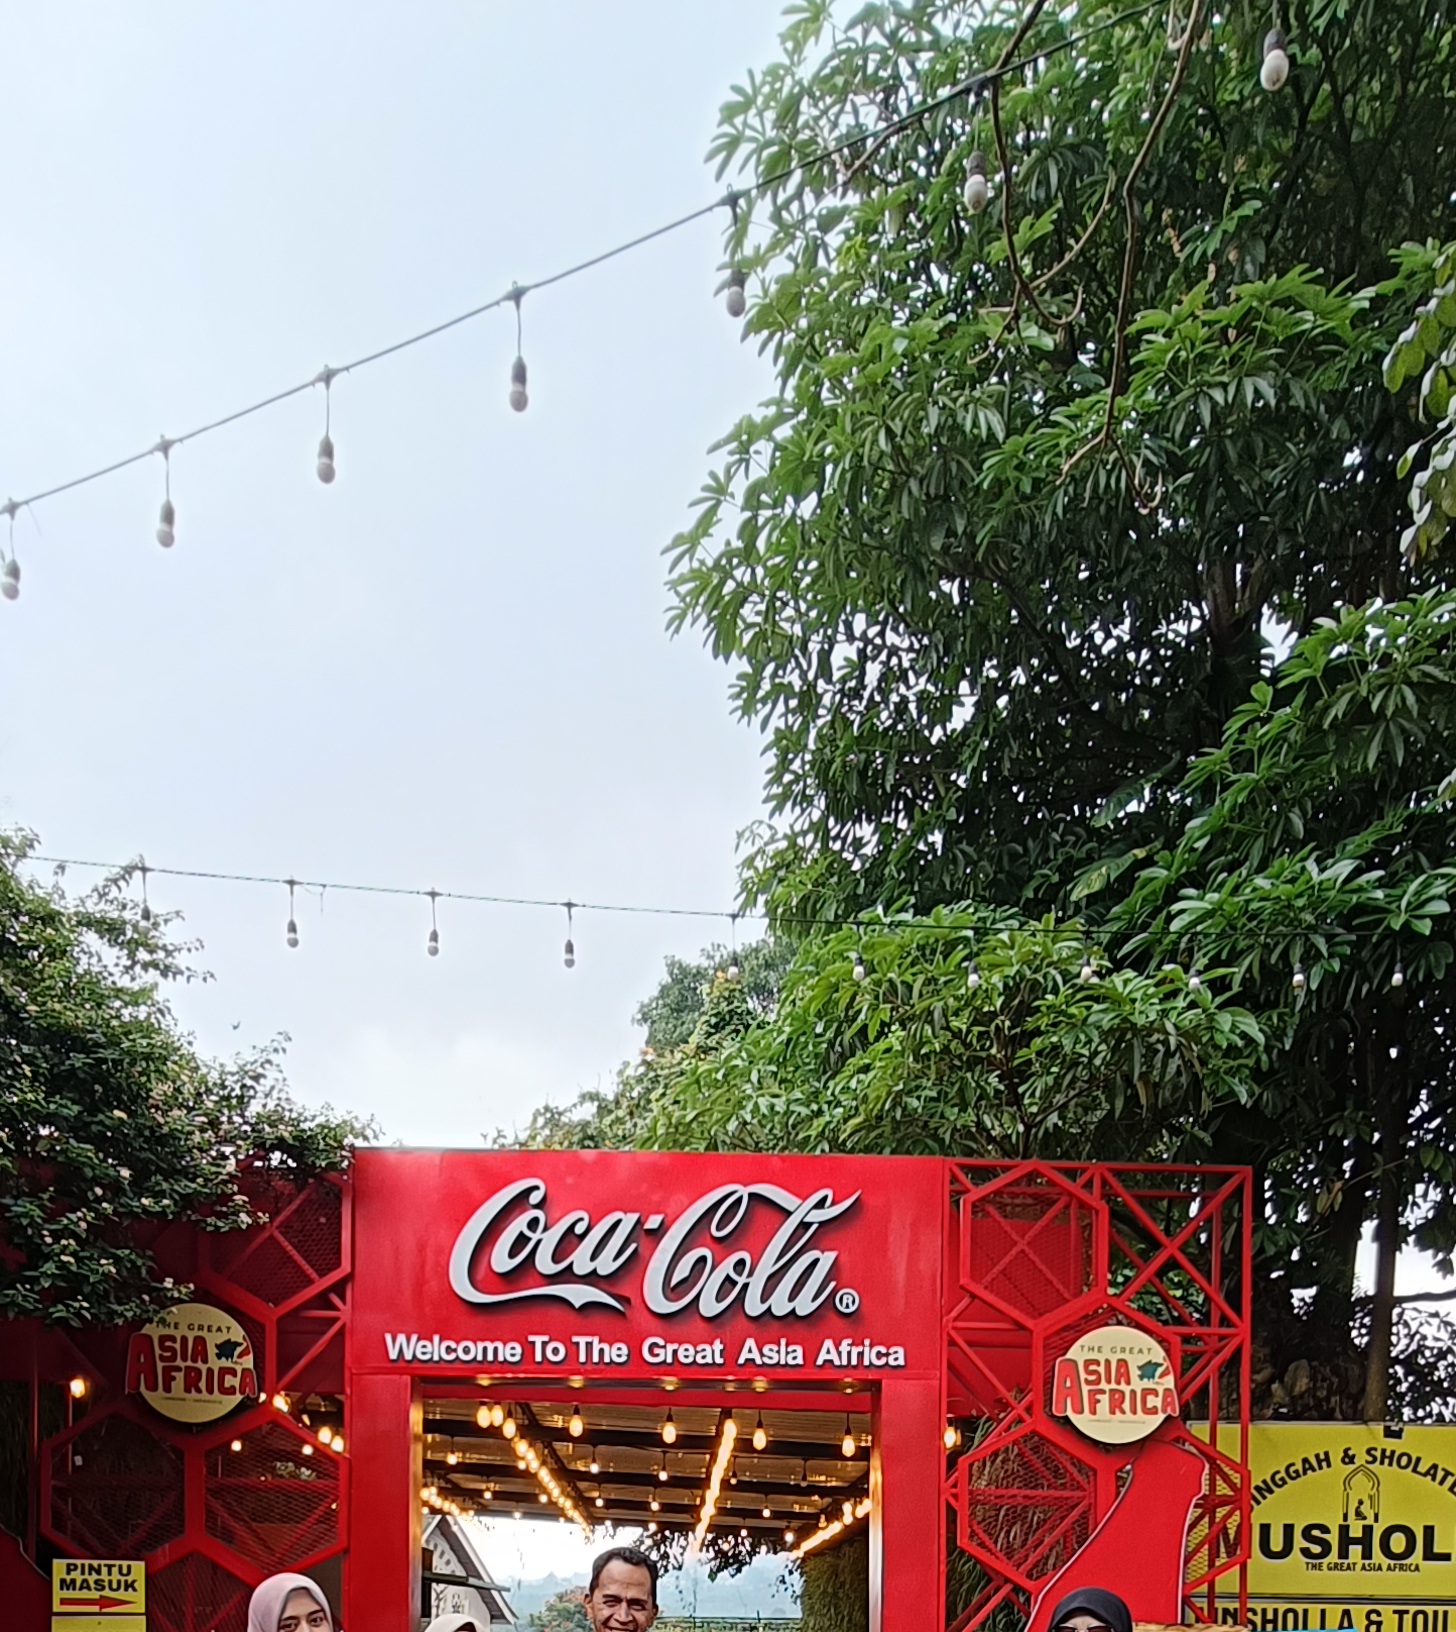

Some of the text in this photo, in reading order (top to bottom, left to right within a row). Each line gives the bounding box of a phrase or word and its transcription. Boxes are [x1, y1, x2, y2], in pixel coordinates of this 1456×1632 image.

[187, 1323, 232, 1334] GREAT
[384, 1333, 906, 1366] Welcome To The Great Asia Africa
[1080, 1345, 1153, 1355] THE GREAT
[1250, 1450, 1332, 1513] INGGAH
[1341, 1447, 1356, 1466] &
[66, 1563, 132, 1577] PINTU
[1305, 1562, 1420, 1573] THE GREAT ASIA AFRICA
[59, 1578, 138, 1592] MASUK
